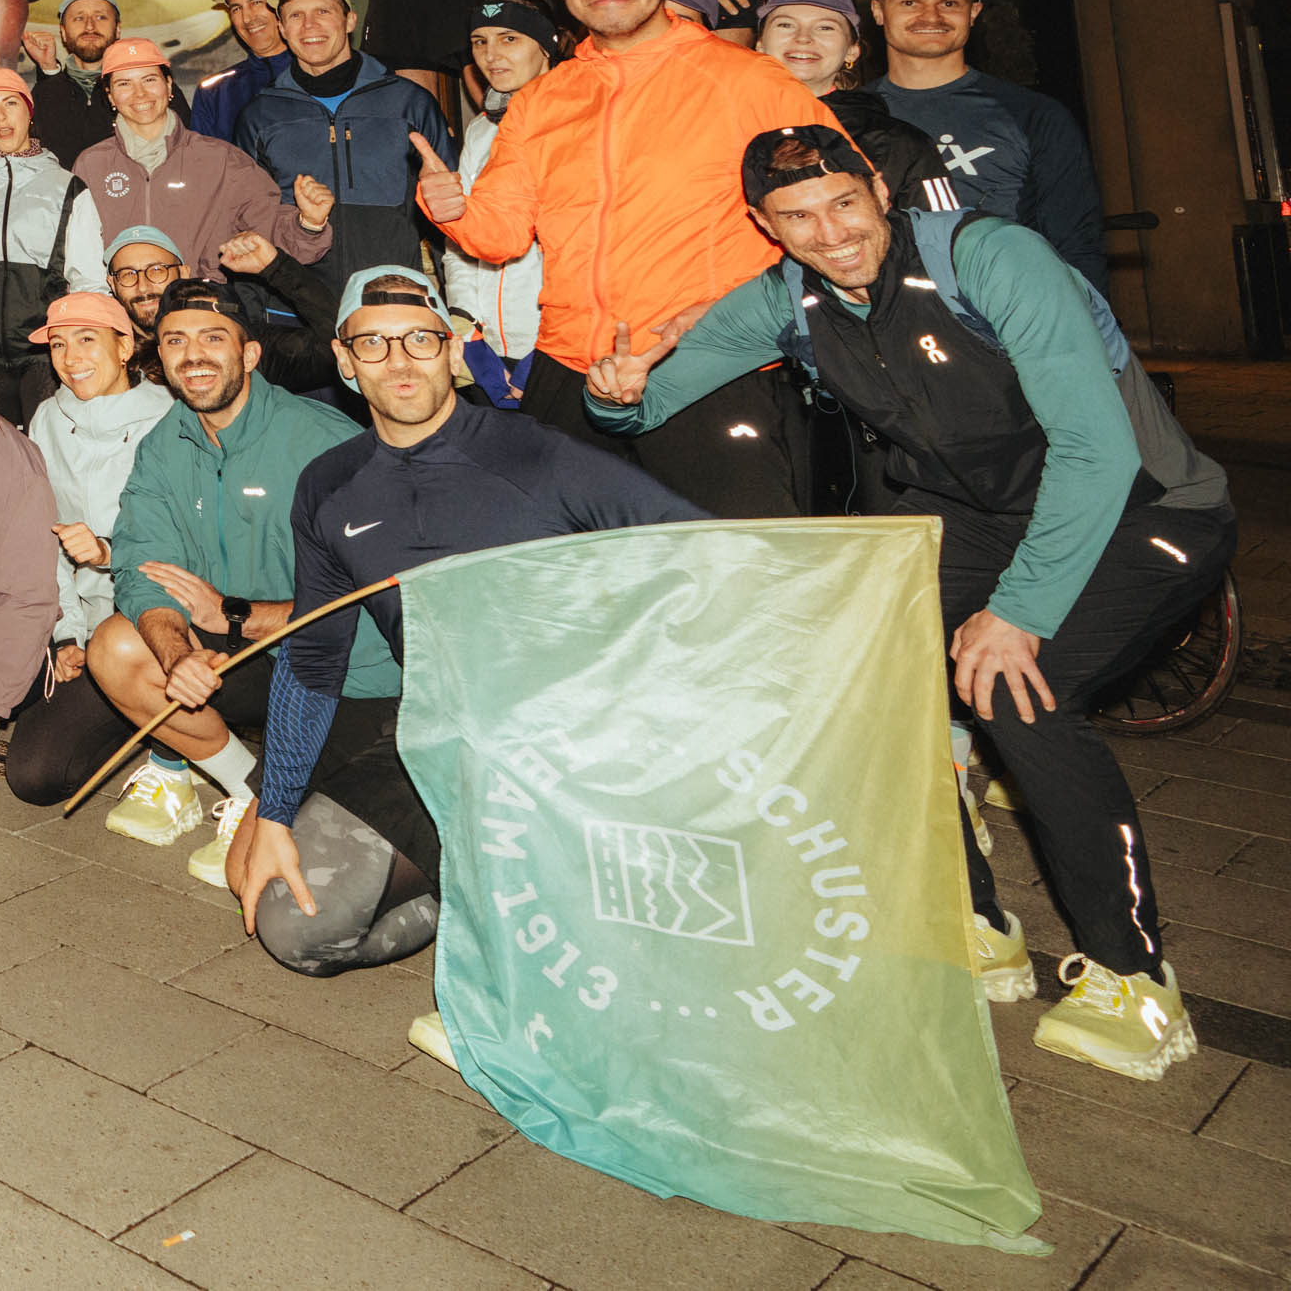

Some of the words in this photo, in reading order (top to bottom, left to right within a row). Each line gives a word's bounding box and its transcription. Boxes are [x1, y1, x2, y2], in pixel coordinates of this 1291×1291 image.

[483, 726, 603, 860] TEAM
[492, 882, 619, 1011] 1913
[715, 748, 872, 1034] SCHUSTER
